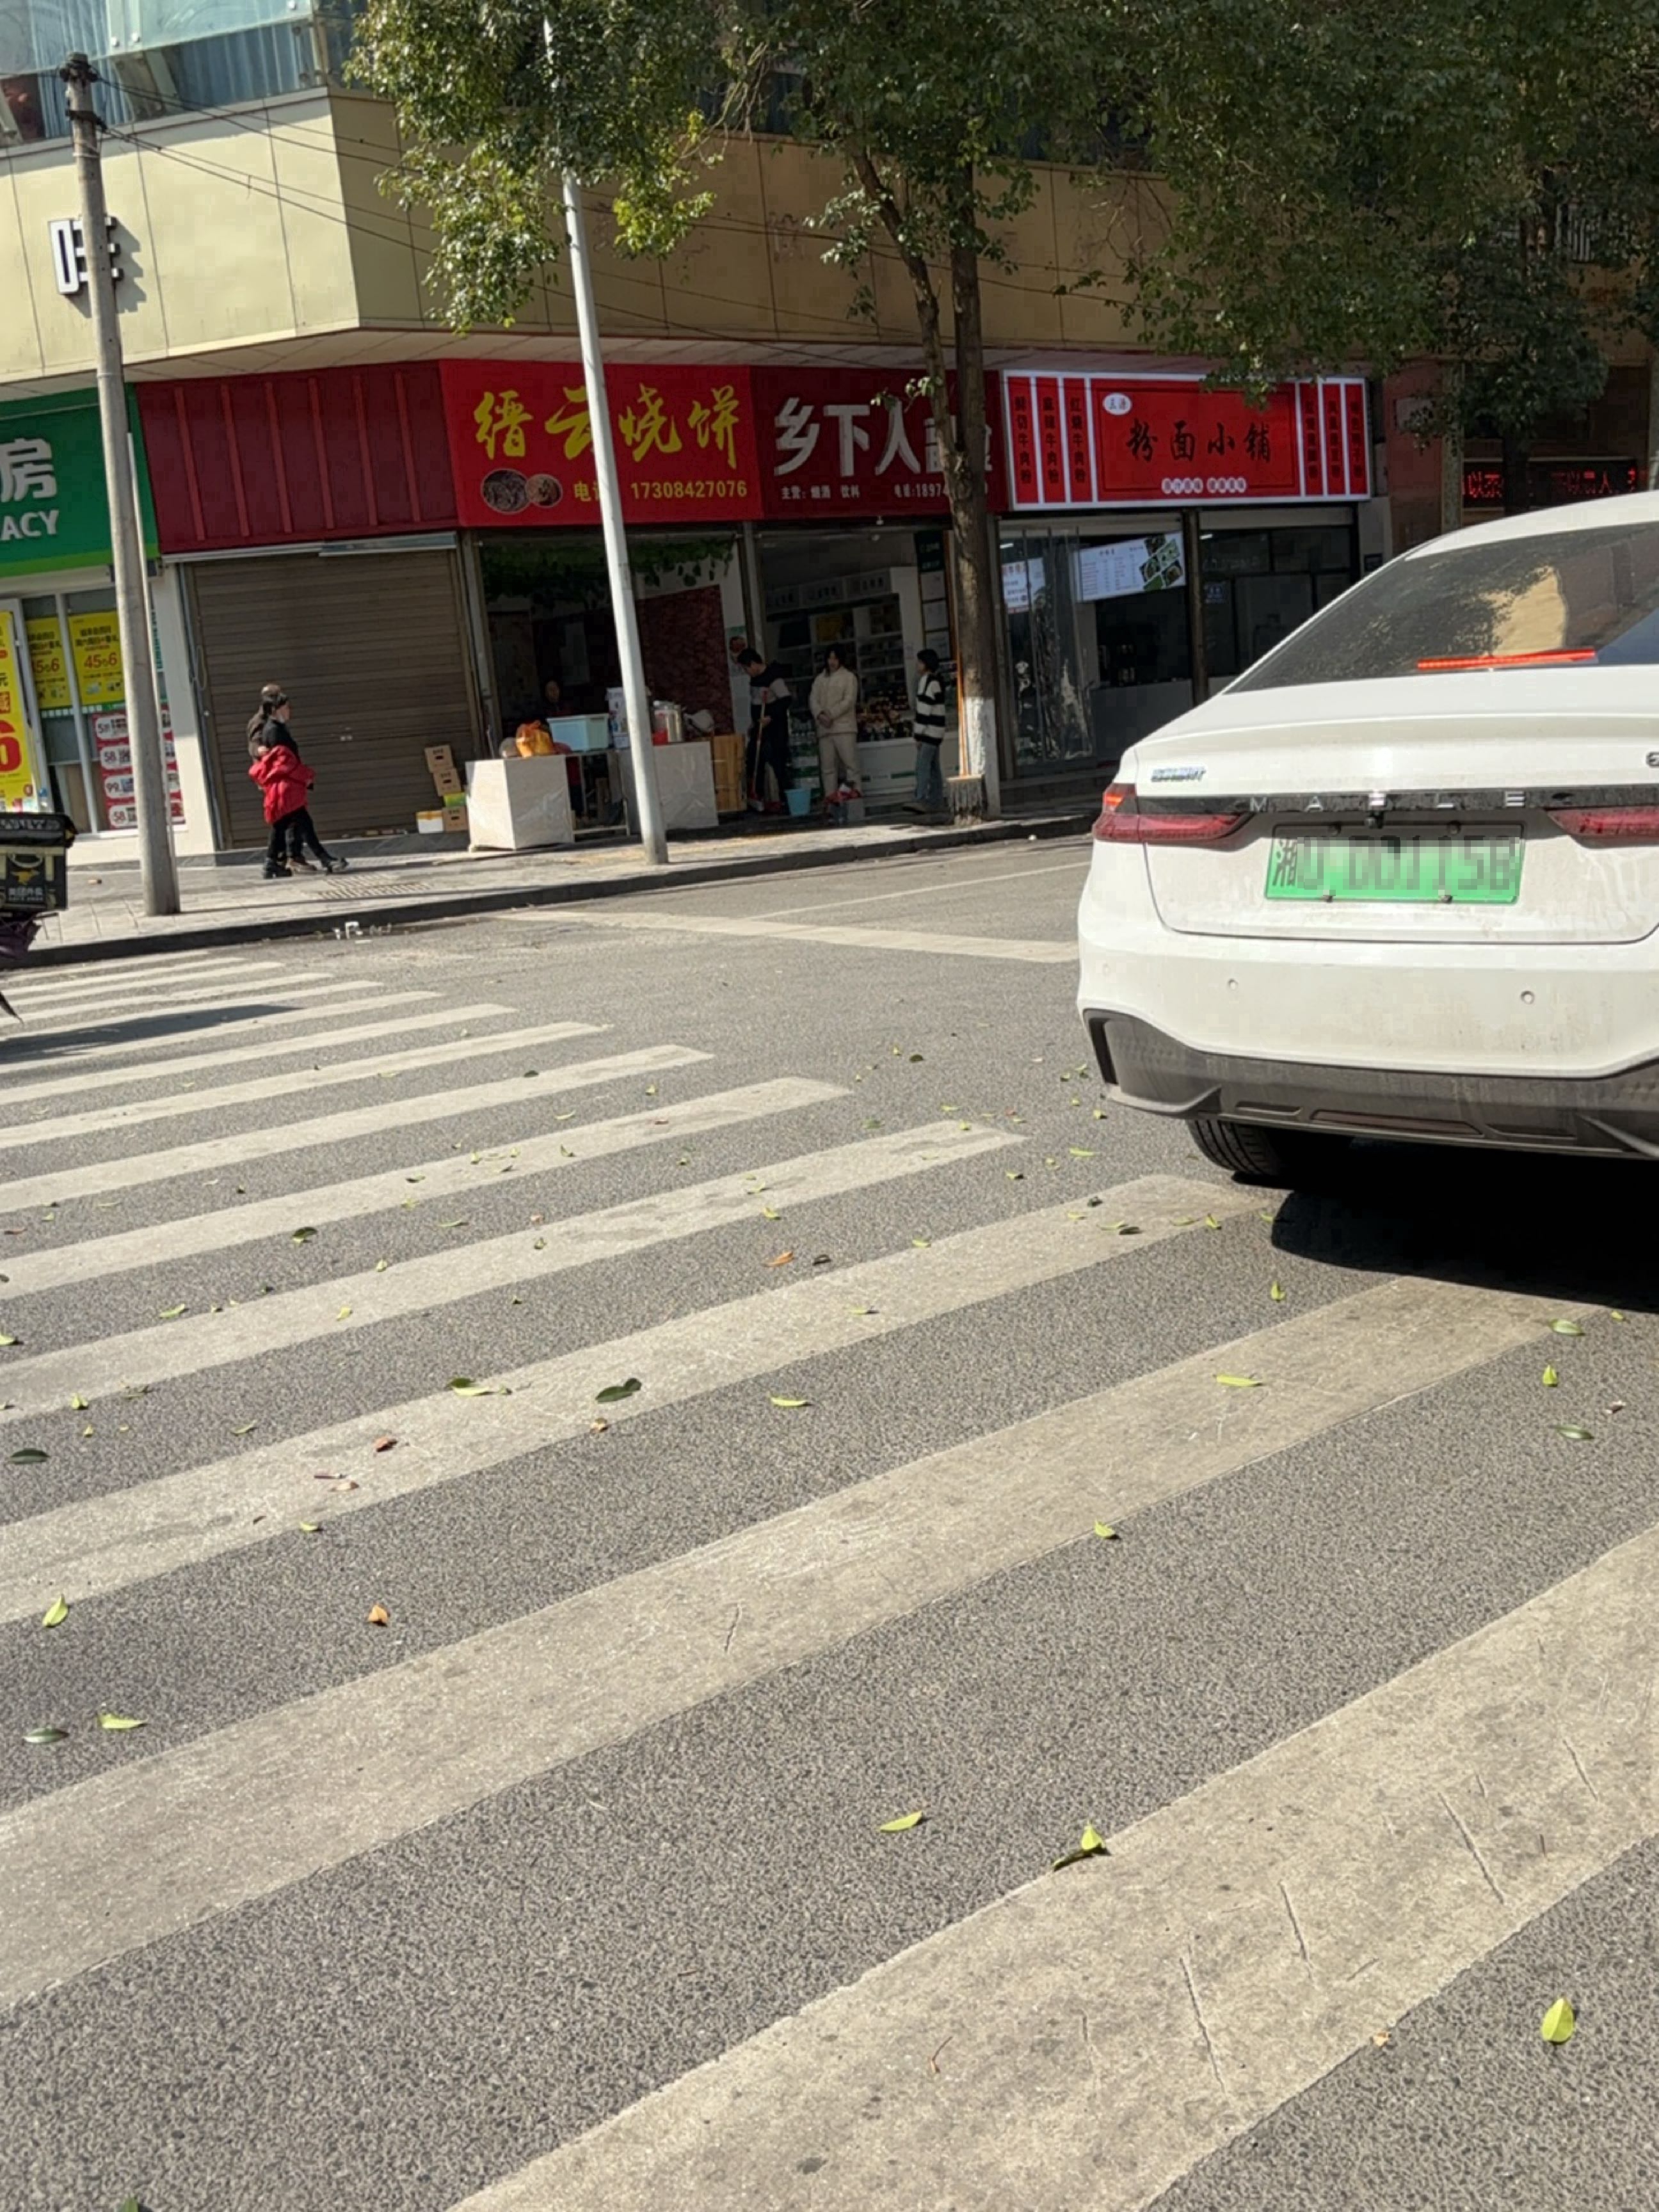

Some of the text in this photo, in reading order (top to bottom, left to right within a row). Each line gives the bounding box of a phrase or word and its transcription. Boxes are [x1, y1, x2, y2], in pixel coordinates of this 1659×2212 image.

[473, 383, 740, 469] 缙云烧饼
[773, 397, 993, 477] 乡下人
[1126, 417, 1270, 463] 粉面小铺
[0, 437, 57, 503] 房
[630, 480, 748, 499] 17308427076
[0, 509, 60, 541] ACY
